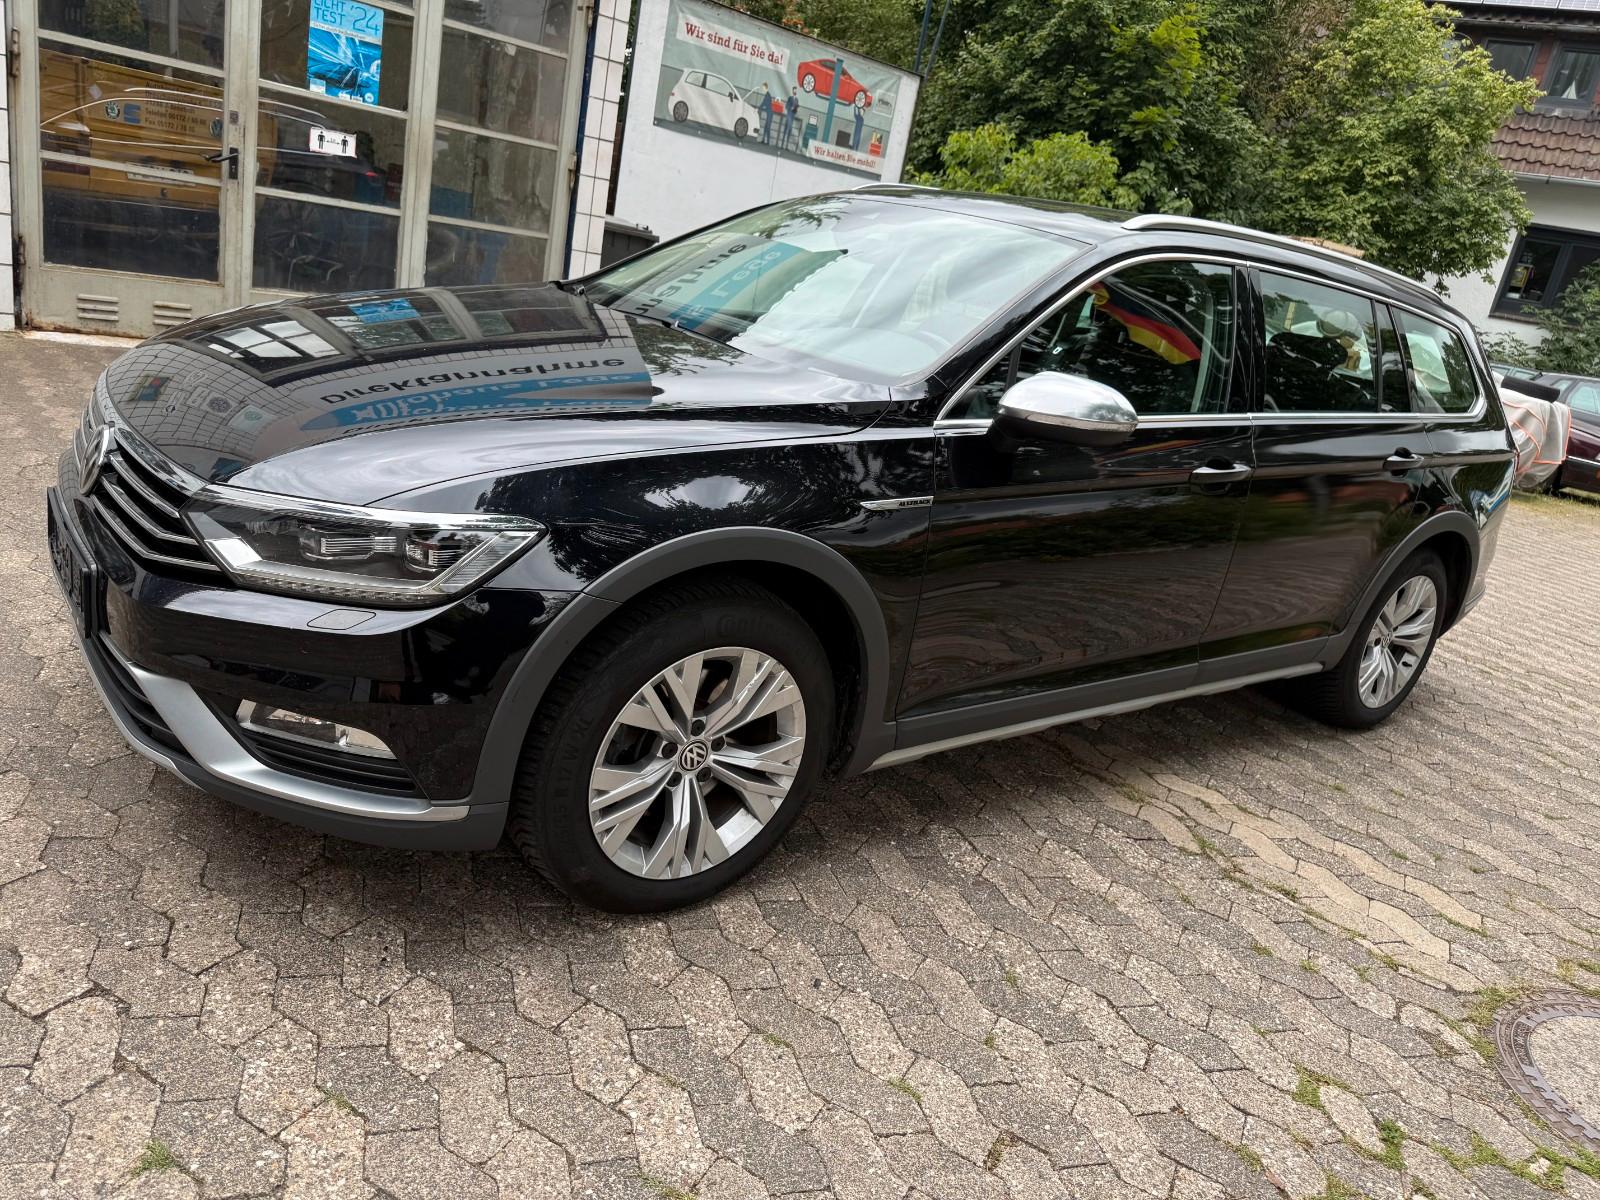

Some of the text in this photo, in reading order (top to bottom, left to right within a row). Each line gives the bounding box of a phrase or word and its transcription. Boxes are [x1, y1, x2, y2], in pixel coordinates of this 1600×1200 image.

[314, 6, 346, 25] TEST
[685, 22, 784, 65] Wir sind für Sie da!
[815, 146, 826, 156] Wir
